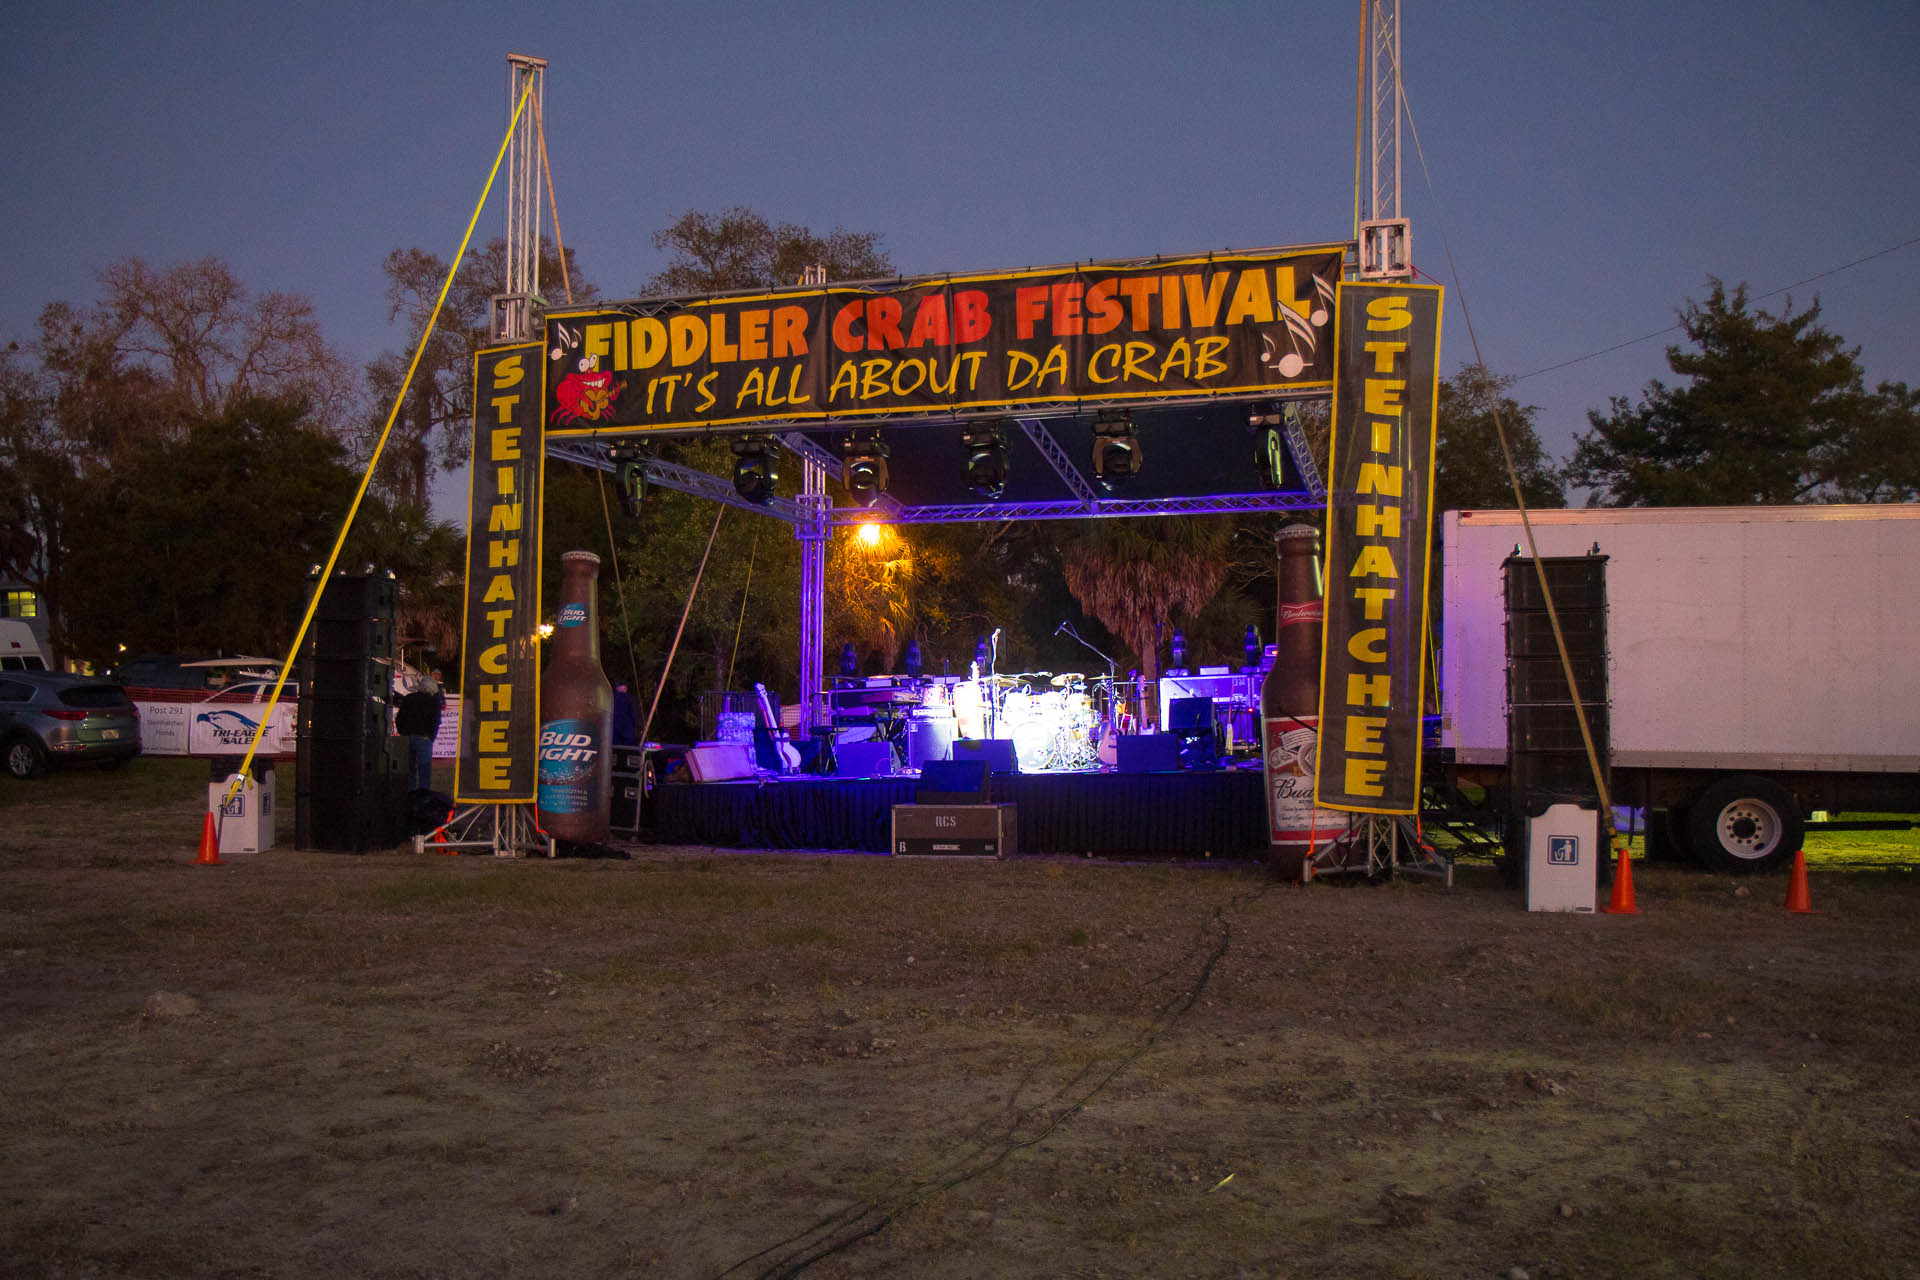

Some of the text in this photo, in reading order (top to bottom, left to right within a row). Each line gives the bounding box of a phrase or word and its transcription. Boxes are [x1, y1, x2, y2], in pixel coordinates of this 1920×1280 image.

[584, 266, 1312, 373] FIDDLER CRAB FESTIVAL
[645, 335, 1231, 415] IT'S ALL ABOUT DA CRAB
[1345, 295, 1413, 798] STEINHATCHEE
[478, 354, 525, 792] STEINHATCHEE
[559, 615, 588, 624] LIGHT
[149, 706, 184, 715] Post 291
[213, 729, 269, 737] TRI-EAGE
[539, 731, 592, 747] BUD
[538, 748, 598, 762] IGHT
